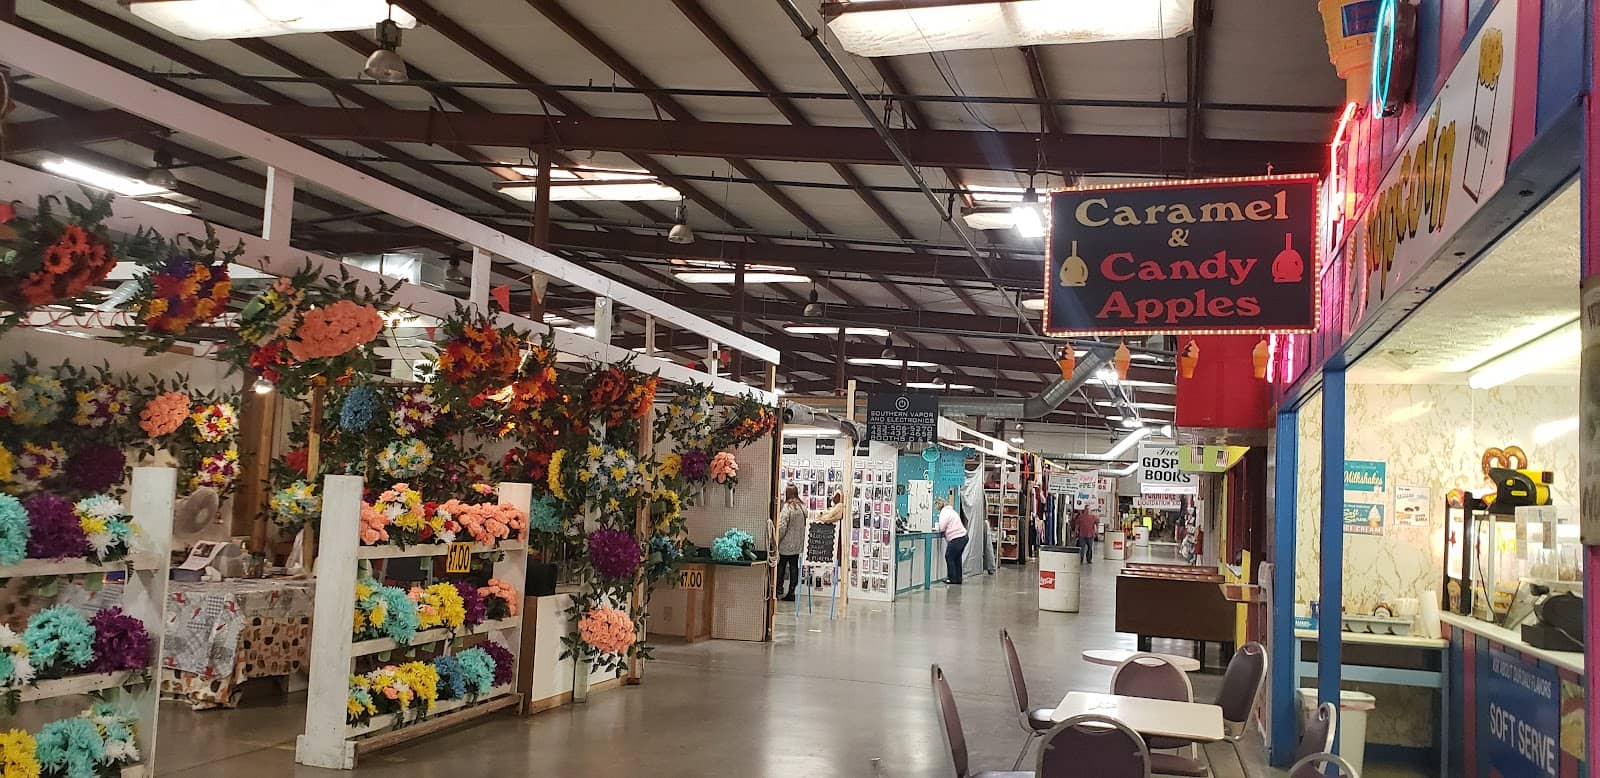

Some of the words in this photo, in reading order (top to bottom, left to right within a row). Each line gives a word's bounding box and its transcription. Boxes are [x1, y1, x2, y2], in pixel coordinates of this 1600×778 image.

[1075, 190, 1288, 227] Caramel
[1167, 228, 1190, 247] &
[1100, 250, 1258, 286] Candy
[1096, 289, 1261, 324] Apples
[1142, 457, 1179, 469] GOSP
[1144, 470, 1191, 483] BOOKS
[1489, 702, 1516, 748] SOFT
[1518, 720, 1556, 776] SERVE
